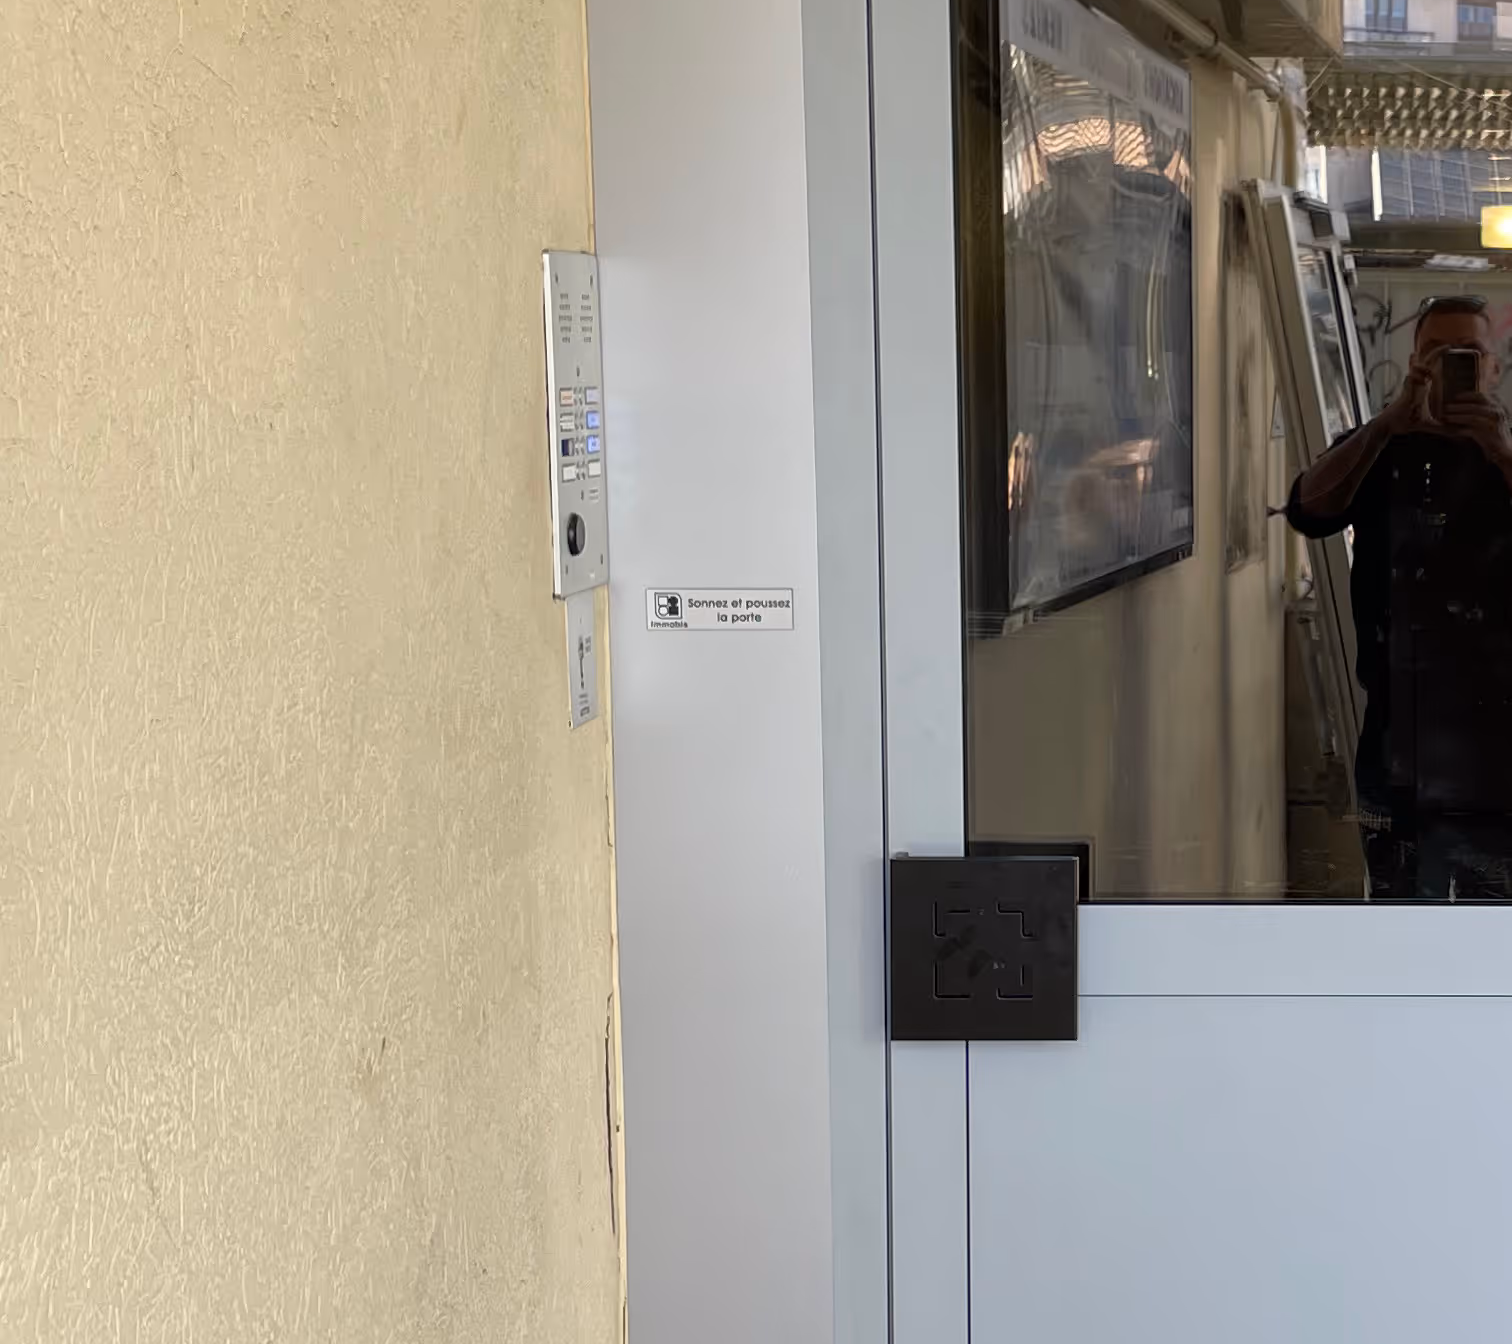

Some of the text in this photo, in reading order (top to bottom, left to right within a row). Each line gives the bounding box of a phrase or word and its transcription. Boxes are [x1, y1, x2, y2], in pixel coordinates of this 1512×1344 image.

[687, 598, 791, 611] Sonnez et poussez
[717, 612, 762, 624] la porte
